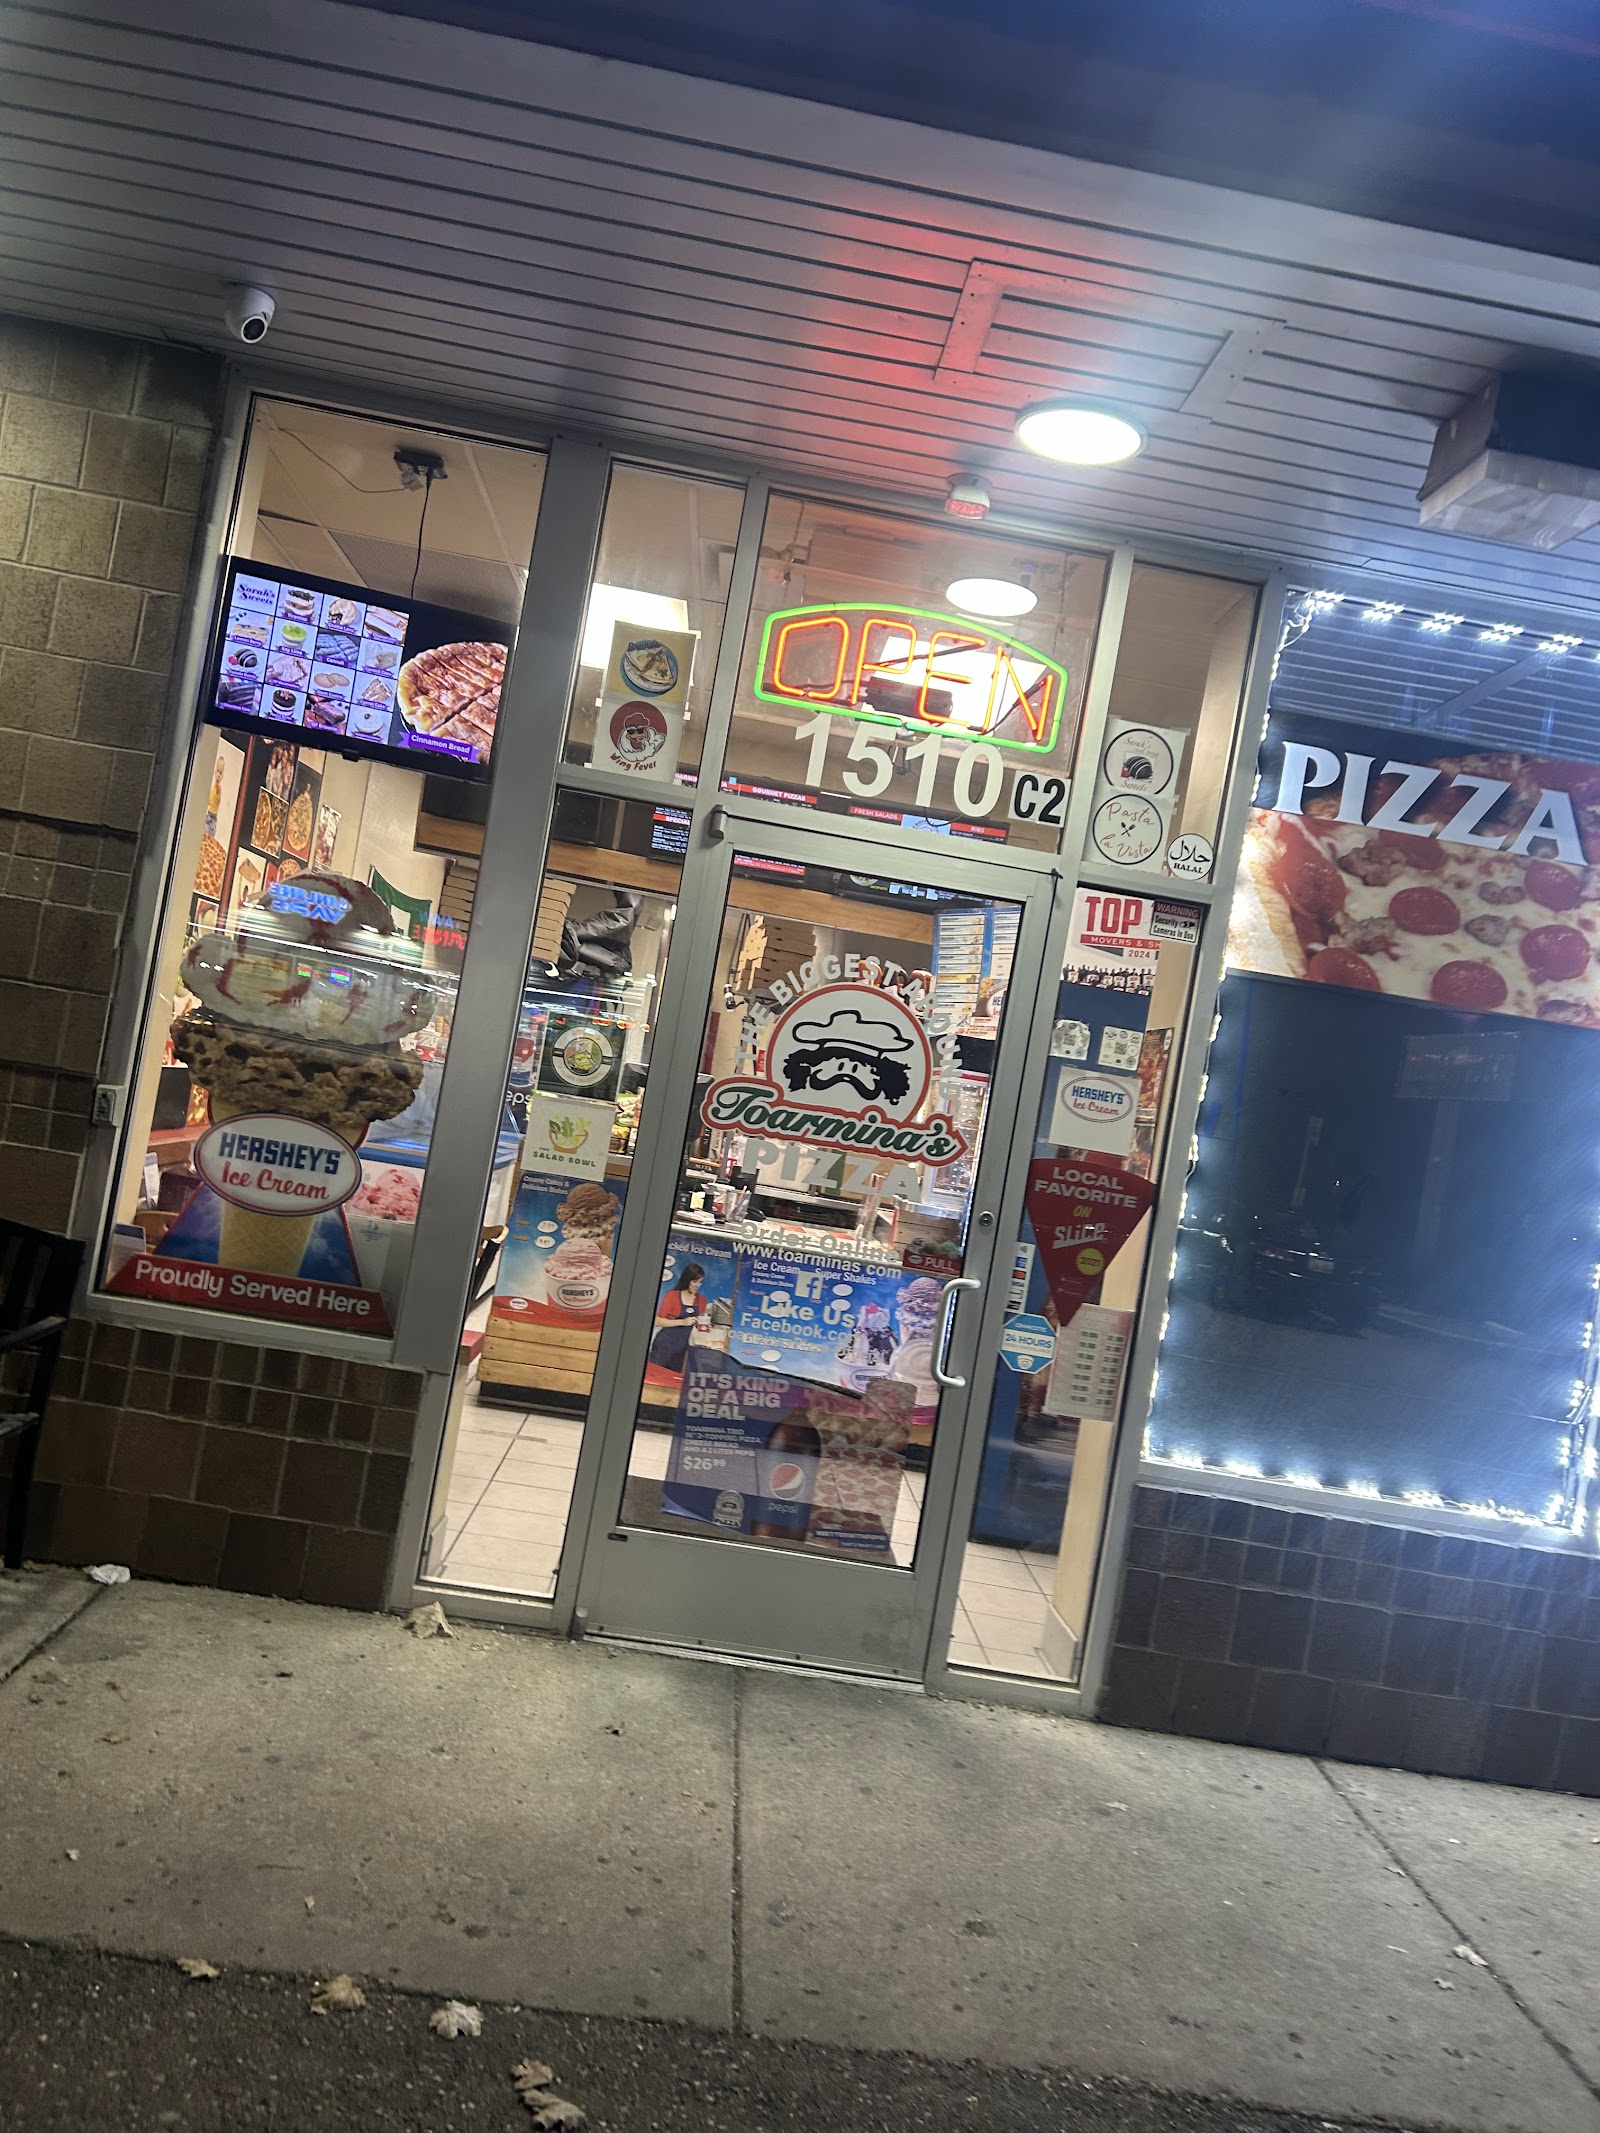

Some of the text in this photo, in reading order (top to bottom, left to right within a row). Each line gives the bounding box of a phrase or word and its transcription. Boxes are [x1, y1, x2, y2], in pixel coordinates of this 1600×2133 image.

[238, 584, 275, 598] Sarah's
[241, 592, 273, 605] Sweets
[772, 616, 1055, 741] OPEN
[410, 734, 471, 754] Cinnamon Bread
[610, 752, 657, 771] Wing Fever
[795, 711, 1004, 817] 1510
[752, 787, 806, 802] GOURMET PIZZAS
[1014, 774, 1067, 825] C2
[1271, 741, 1590, 866] PIZZA
[854, 807, 898, 821] FRESH SALADS
[1106, 802, 1154, 825] Pasta
[970, 826, 986, 835] RIBS
[1117, 841, 1153, 858] Vista
[1169, 839, 1211, 863] حلال
[1173, 863, 1204, 874] HALAL
[1085, 896, 1143, 935] TOP
[1156, 903, 1199, 918] WARNING
[1154, 915, 1179, 929] Security
[1091, 936, 1132, 947] MOVERS
[1153, 925, 1177, 937] Cameras
[1184, 931, 1194, 940] Use
[1128, 949, 1151, 959] 2024
[735, 1002, 774, 1068] THE
[768, 953, 901, 1006] BIGGEST
[900, 978, 962, 1101] AROUND
[506, 1090, 532, 1107] eps
[1071, 1085, 1125, 1105] HERSHEY'S
[1073, 1098, 1119, 1115] Ice Cream
[711, 1086, 958, 1158] Toarmina's
[218, 1132, 341, 1175] HERSHEY'S
[533, 1151, 596, 1168] SALAD BOWL
[221, 1161, 330, 1199] Ice Cream
[741, 1138, 922, 1204] PIZZA
[1053, 1166, 1125, 1190] LOCAL
[1034, 1180, 1139, 1209] FAVORITE
[1072, 1205, 1093, 1219] ON
[690, 1244, 704, 1254] Ice
[705, 1246, 732, 1259] Cream
[740, 1222, 900, 1263] Order Online
[753, 1259, 801, 1275] Ice Cream
[925, 1257, 956, 1272] PULL
[815, 1267, 877, 1286] Super Shakes
[135, 1259, 370, 1316] Proudly Served Here
[562, 1288, 595, 1297] HERSHEY'S
[823, 1305, 856, 1328] Us
[740, 1312, 858, 1342] Facebook.co
[1005, 1333, 1017, 1342] 24
[1018, 1335, 1053, 1349] HOURS
[688, 1371, 790, 1393] IT'S KIND
[687, 1387, 781, 1408] OF A BIG
[686, 1402, 746, 1421] DEAL
[768, 1502, 799, 1515] pepsi
